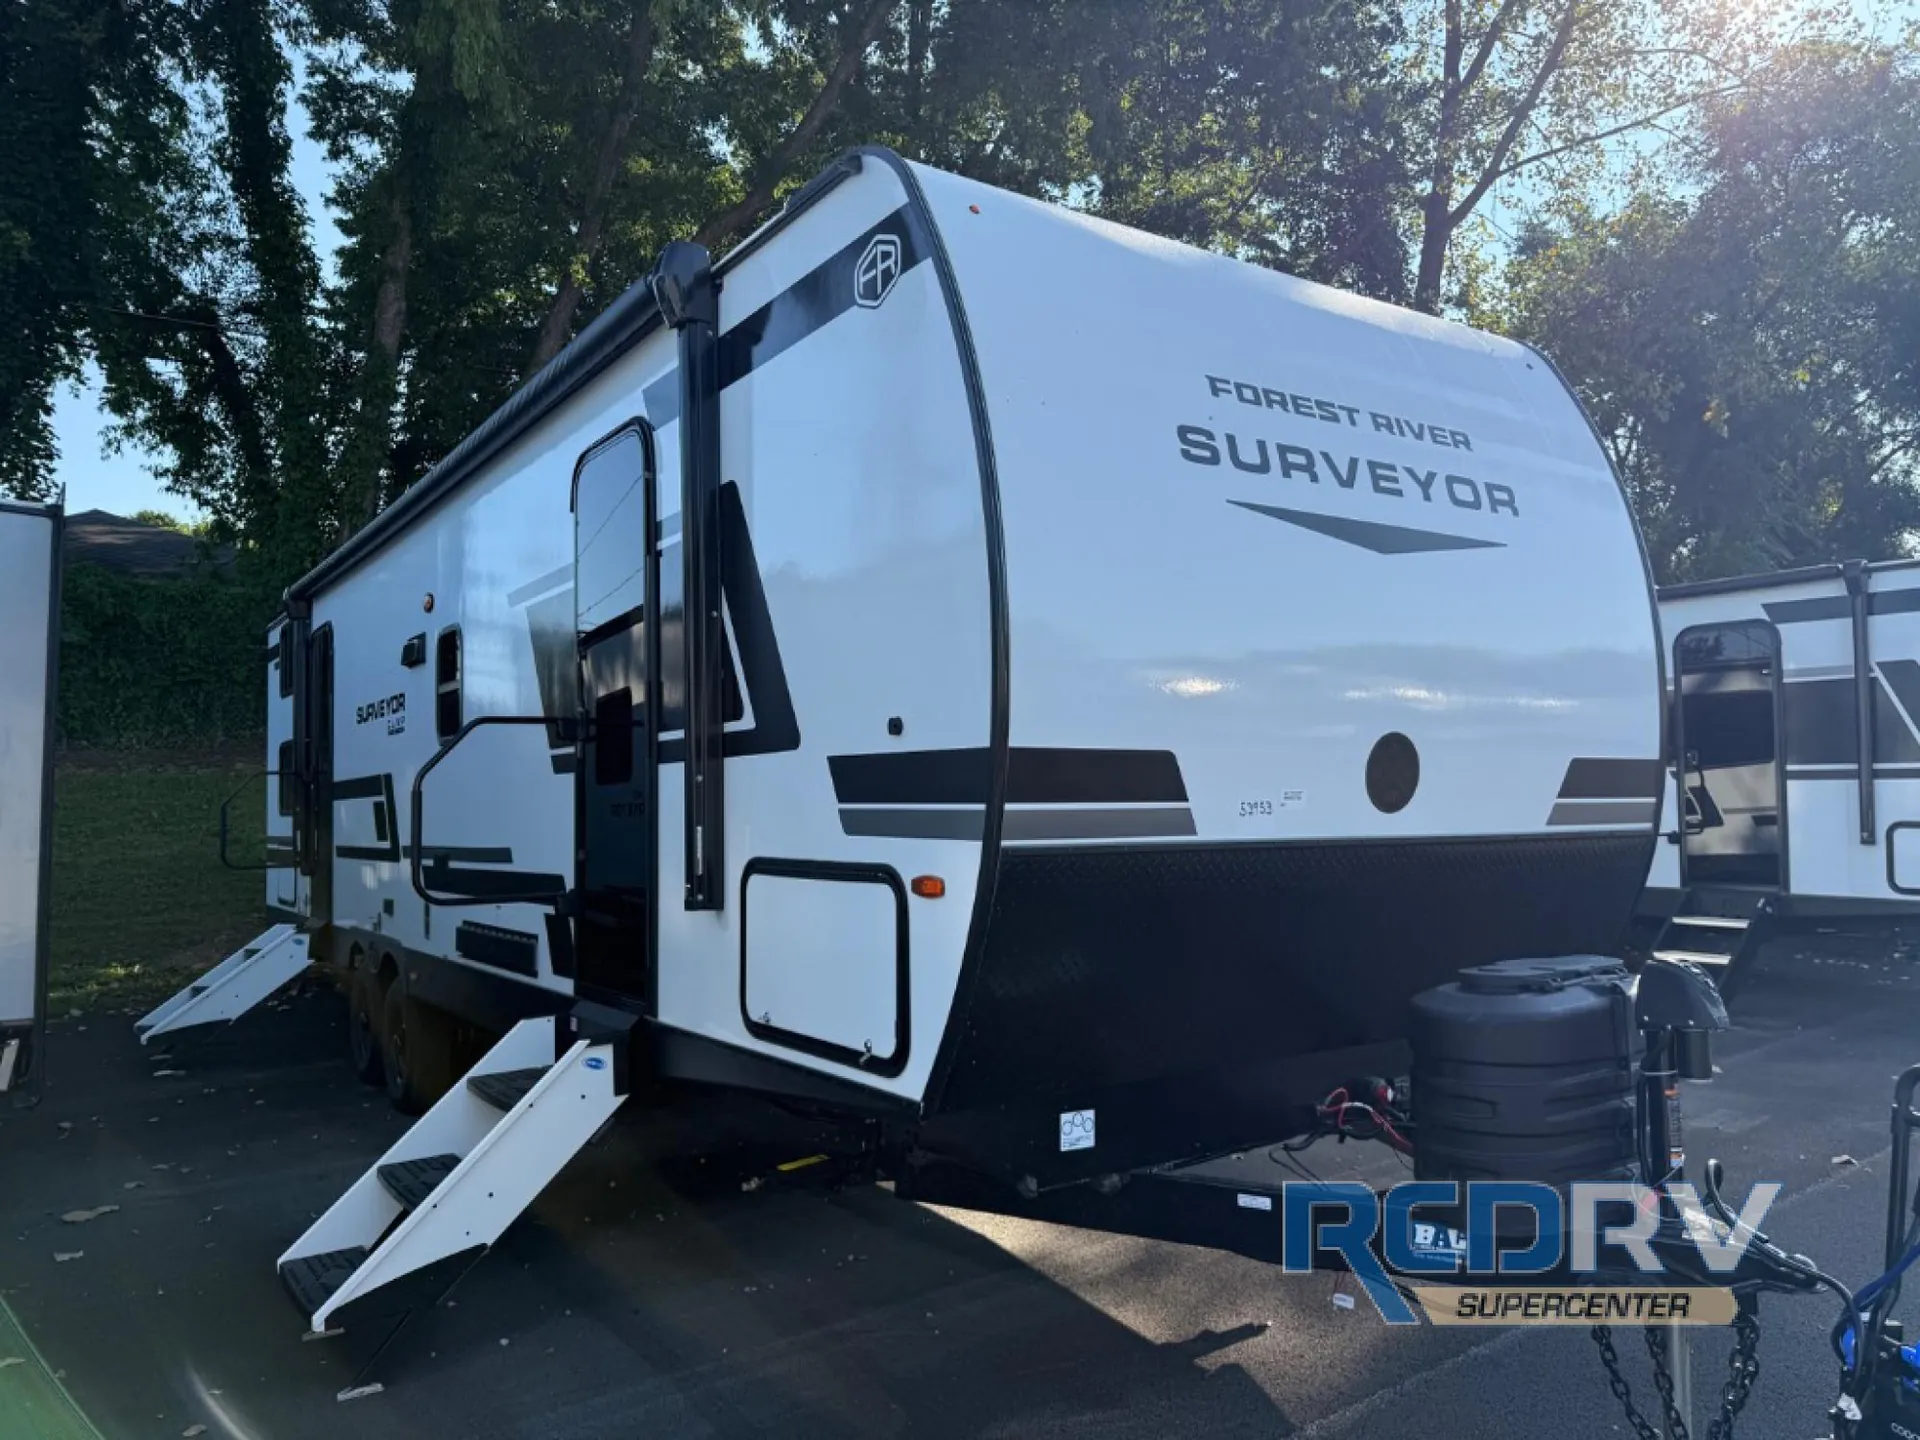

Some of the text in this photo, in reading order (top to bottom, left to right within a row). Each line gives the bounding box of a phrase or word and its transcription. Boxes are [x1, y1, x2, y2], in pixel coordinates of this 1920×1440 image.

[1204, 374, 1474, 452] FOREST RIVER
[1176, 423, 1520, 518] SURVEYOR
[355, 691, 406, 725] SURVEYOR
